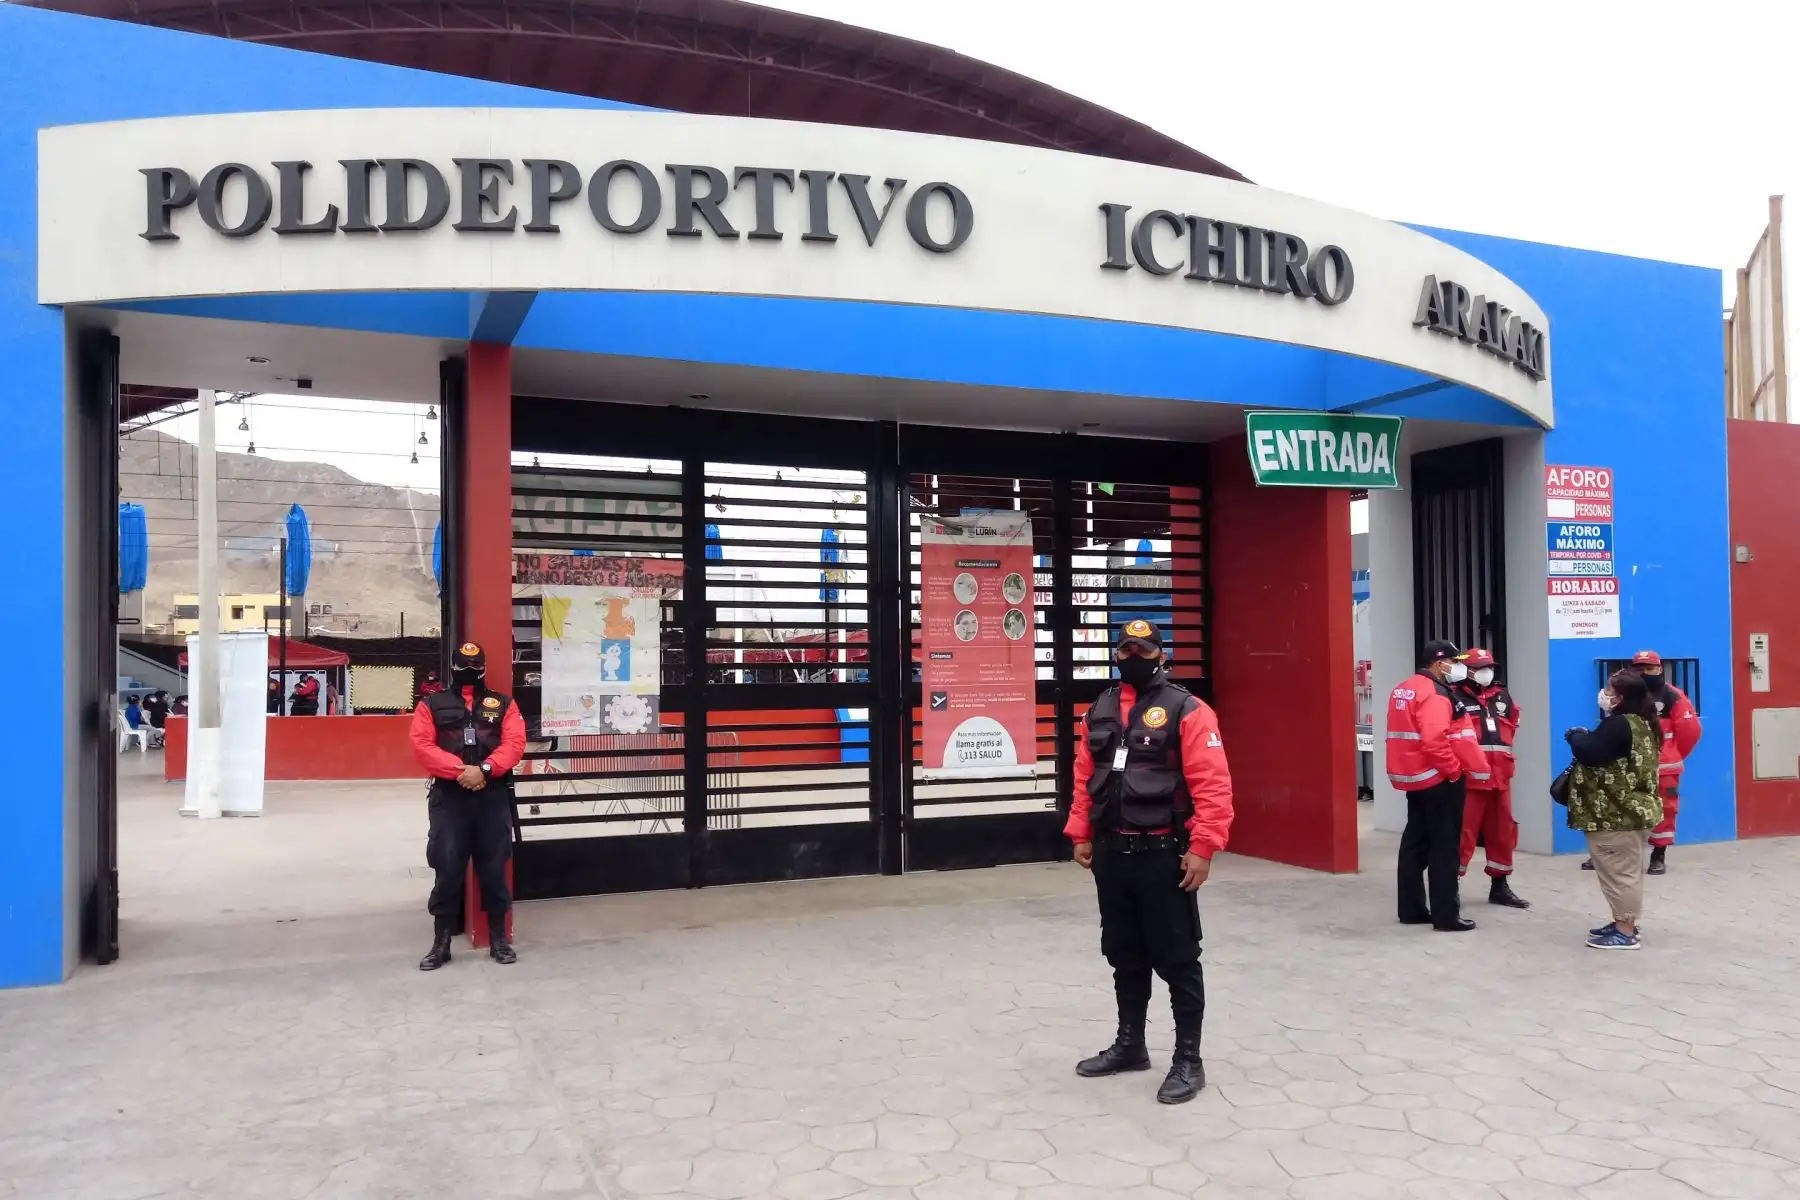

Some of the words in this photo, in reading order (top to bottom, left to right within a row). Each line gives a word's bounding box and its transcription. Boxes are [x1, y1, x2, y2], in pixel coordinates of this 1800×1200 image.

[138, 157, 974, 253] POLIDEPORTIVO
[1098, 202, 1354, 306] ICHIRO
[1412, 274, 1547, 382] ARAKAKI
[1254, 429, 1391, 474] ENTRADA
[1546, 468, 1610, 489] AFORO
[1547, 488, 1584, 497] CAPACIDAD
[1575, 503, 1611, 517] PERSONAS
[1560, 525, 1601, 537] AFORO
[1556, 537, 1606, 550] MÁXIMO
[517, 554, 541, 570] NO
[1572, 562, 1611, 573] PERSONAS
[1551, 580, 1616, 594] HORARIO
[956, 740, 975, 749] llama
[976, 739, 995, 750] gratis
[996, 738, 1003, 747] al
[964, 751, 978, 760] 113
[979, 750, 1003, 759] SALUD
